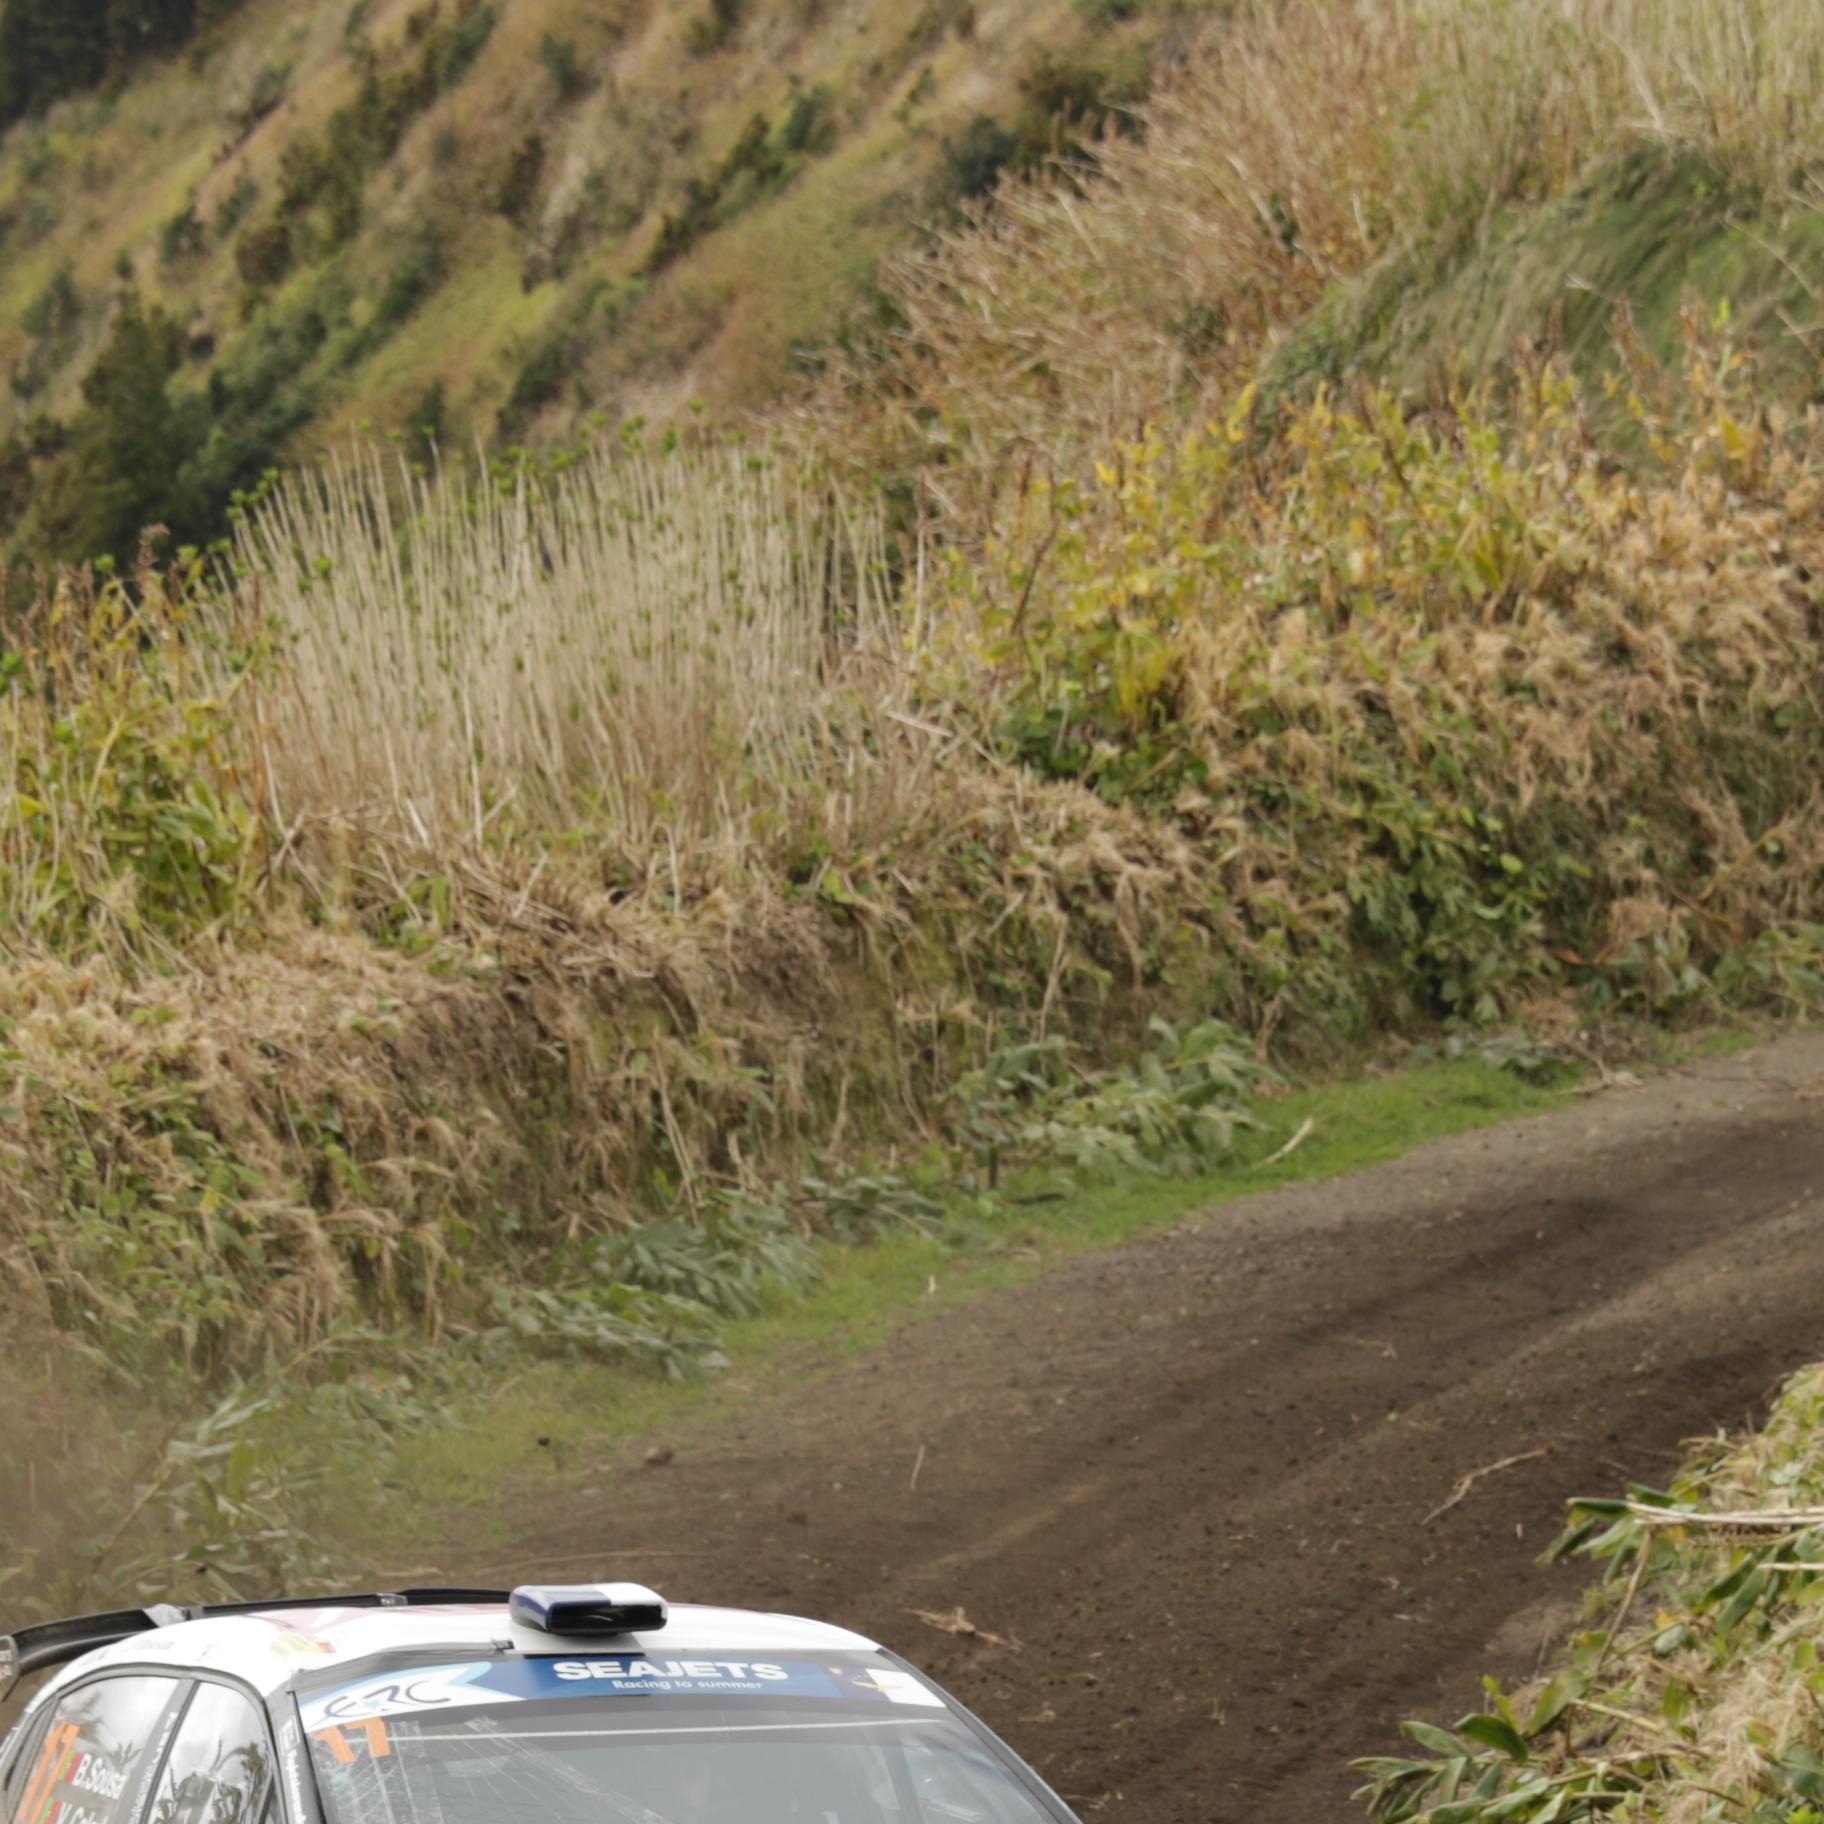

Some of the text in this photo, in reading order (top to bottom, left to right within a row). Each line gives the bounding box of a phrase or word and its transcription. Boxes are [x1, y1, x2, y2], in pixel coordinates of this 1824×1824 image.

[552, 1661, 789, 1681] SEAJETS
[612, 1679, 764, 1690] Racing to summer
[314, 1716, 390, 1765] 17
